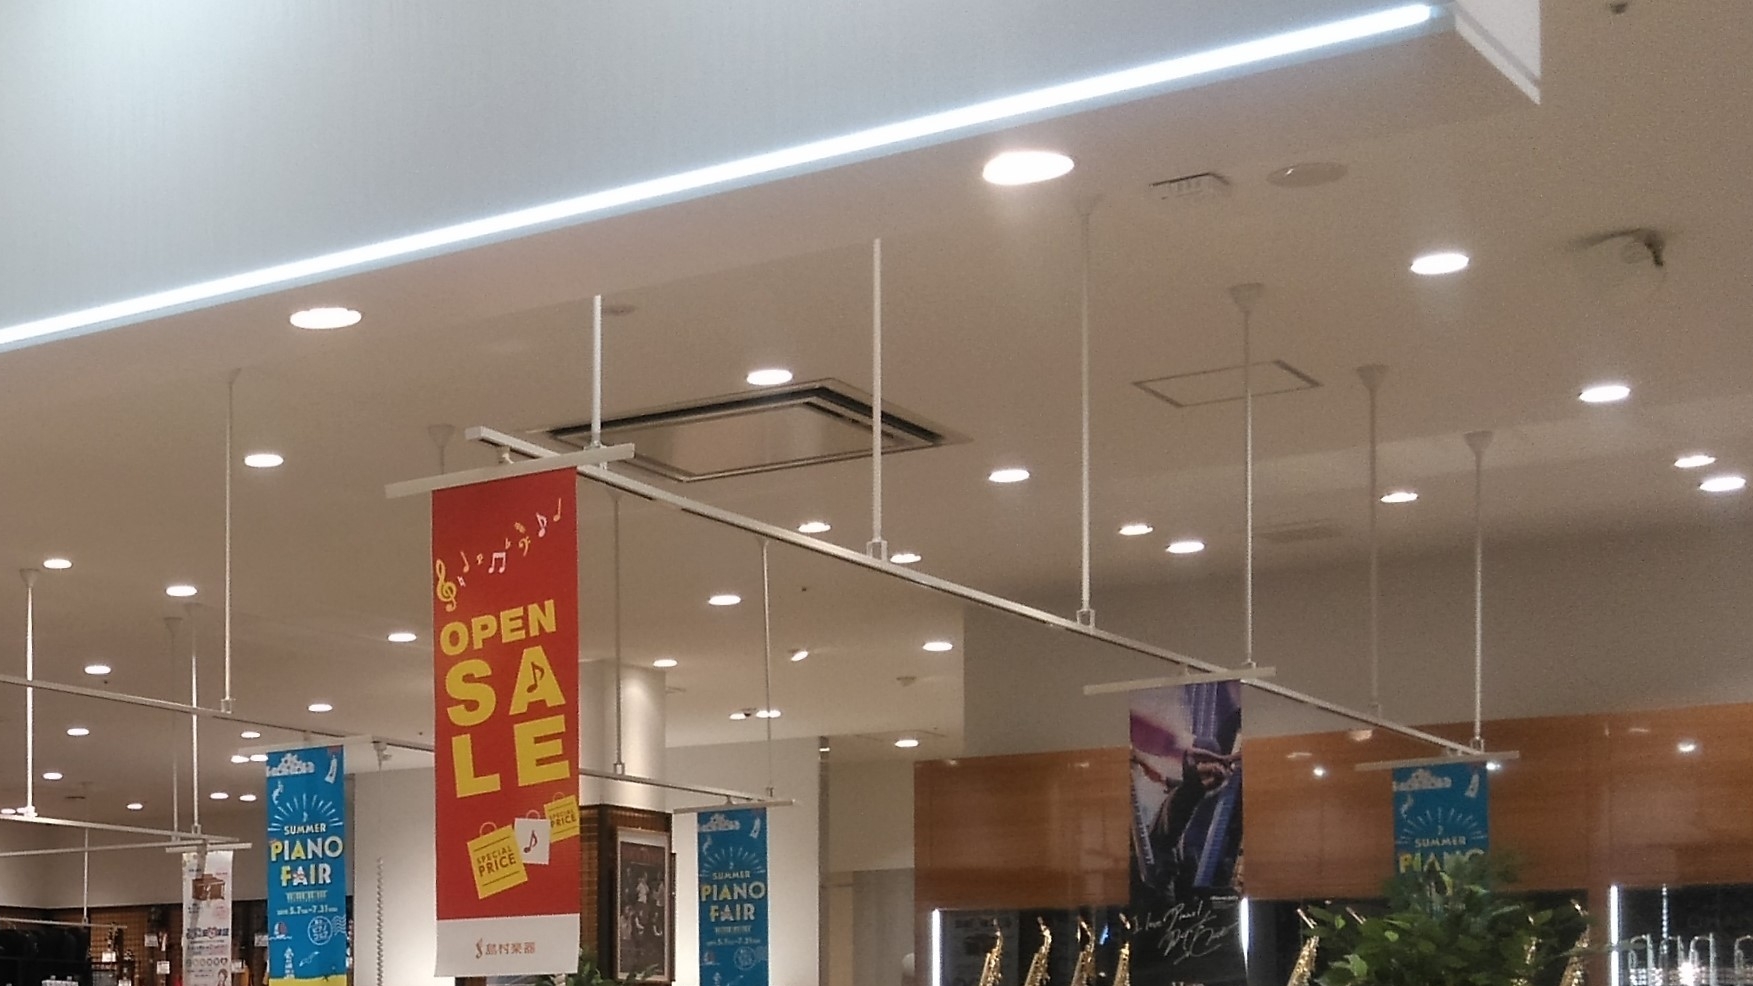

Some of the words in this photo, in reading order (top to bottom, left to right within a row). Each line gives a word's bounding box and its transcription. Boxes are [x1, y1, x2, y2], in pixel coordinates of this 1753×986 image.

[440, 599, 557, 656] OPEN
[284, 822, 327, 835] SUMMER
[551, 815, 576, 829] PRICE
[270, 836, 344, 862] PIANO
[1415, 836, 1466, 848] SUMMER
[477, 846, 512, 865] SPECIAL
[478, 852, 517, 878] PRICE
[280, 863, 332, 887] FAIR
[712, 870, 751, 880] SUMMER
[700, 881, 766, 902] PIANO
[709, 903, 756, 923] FAIR
[485, 941, 537, 956] 島村楽器
